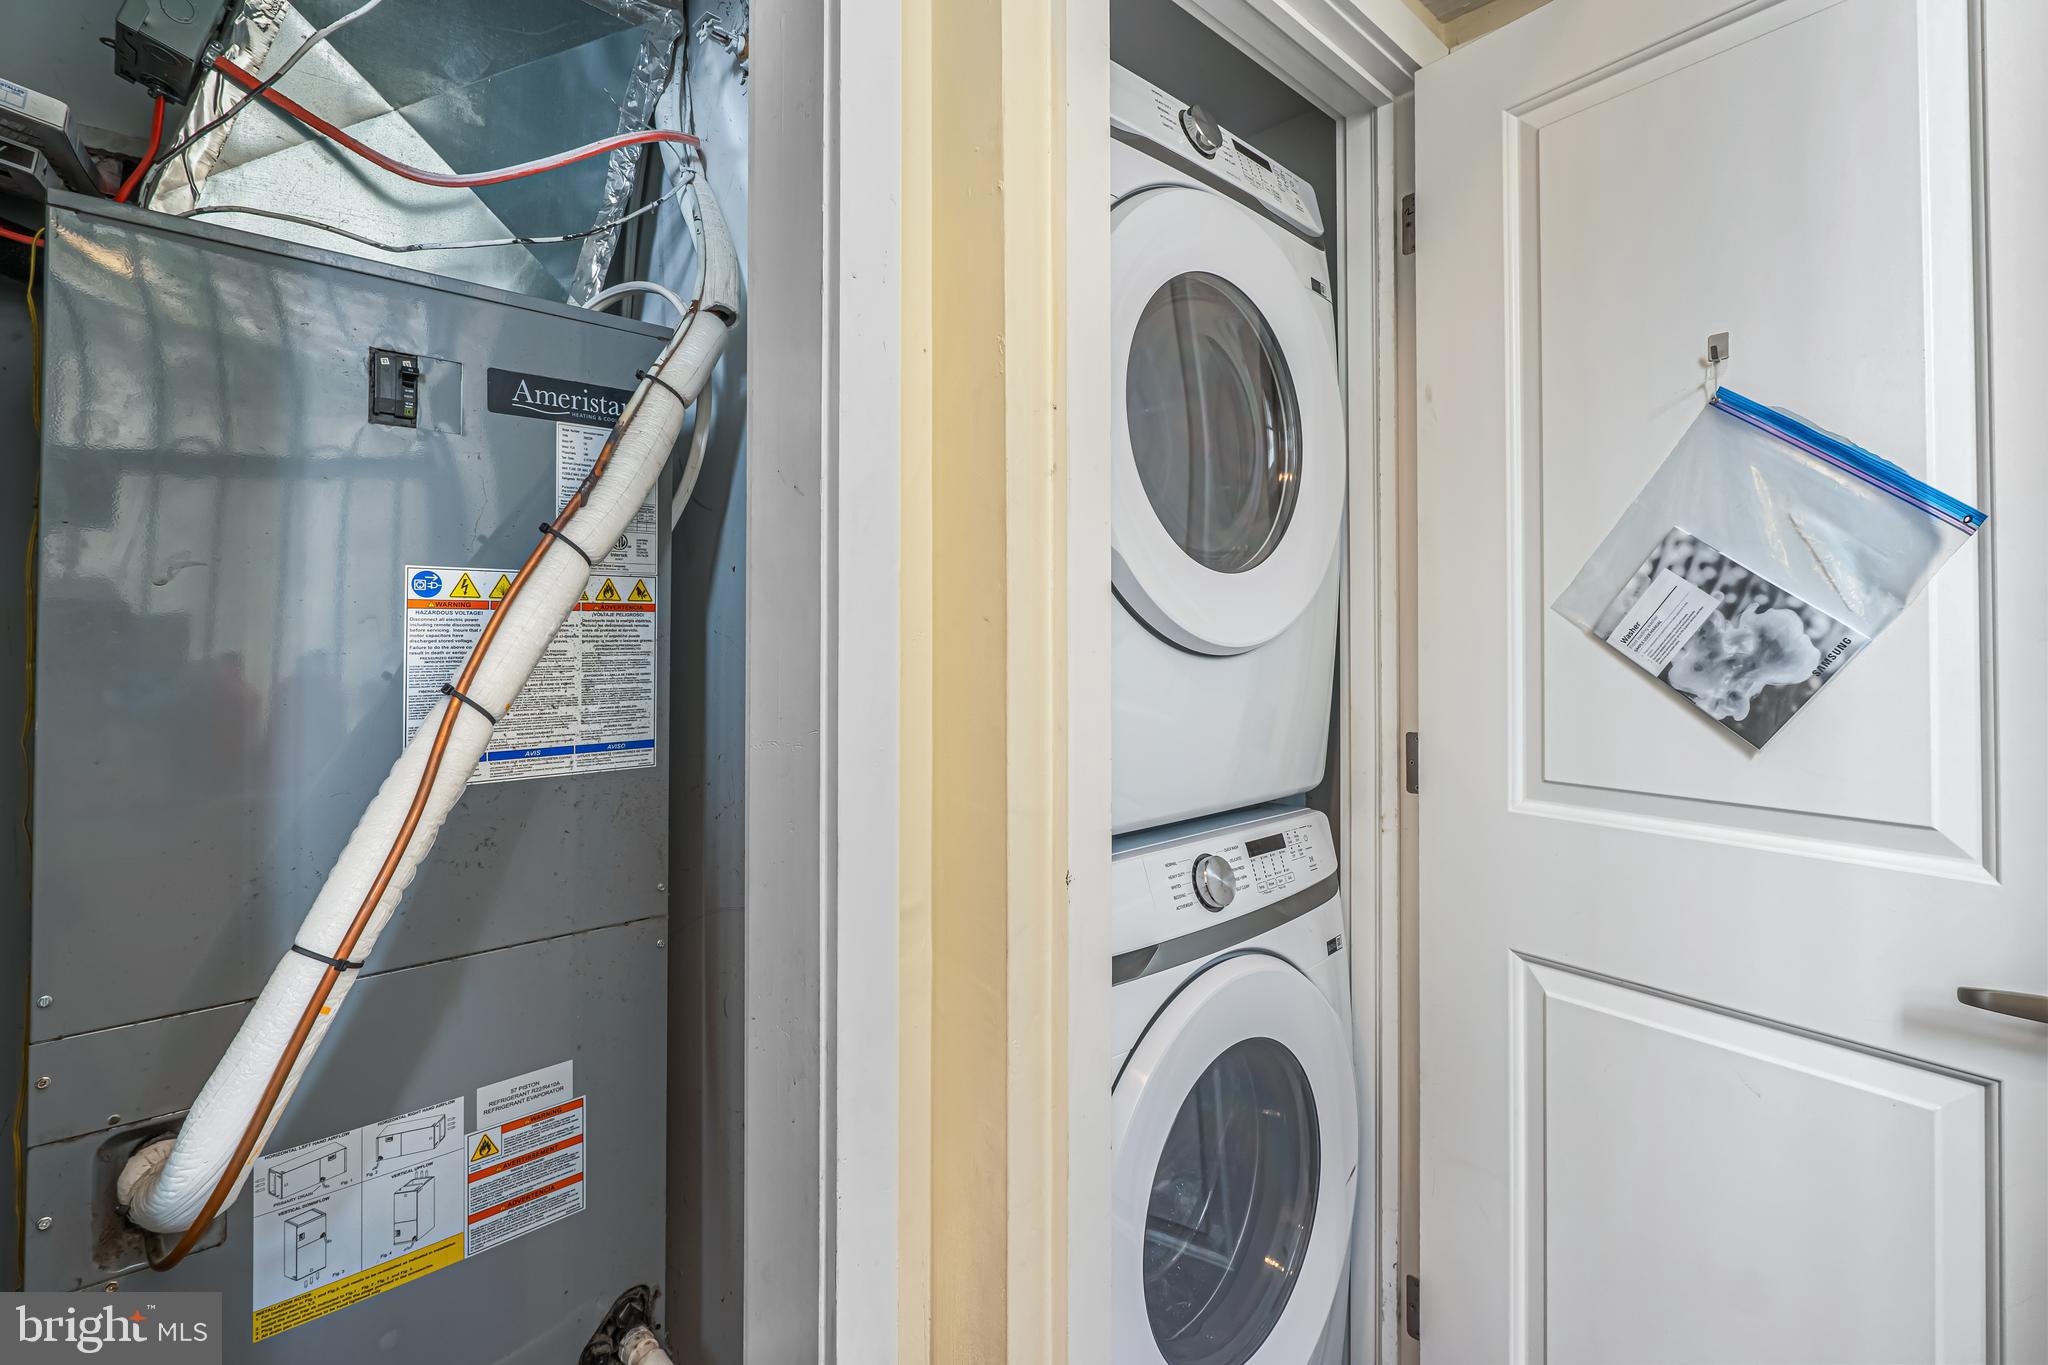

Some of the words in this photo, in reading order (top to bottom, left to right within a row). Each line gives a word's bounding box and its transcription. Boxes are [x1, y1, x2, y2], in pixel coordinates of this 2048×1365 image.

[571, 412, 597, 420] HEATING
[1620, 622, 1641, 644] Washer
[1812, 637, 1852, 676] SAMSUNG
[519, 1081, 540, 1091] PISTON
[483, 1096, 525, 1115] REFRIGERANT
[526, 1086, 564, 1102] EVAPORATOR
[489, 1090, 530, 1107] REFRIGERANT
[378, 1115, 406, 1126] HORIZONTAL
[436, 1100, 456, 1108] AIRFLOW
[531, 1108, 562, 1122] WARNING
[264, 1148, 297, 1160] HORIZONTAL
[328, 1132, 350, 1141] AIRFLOW
[391, 1168, 414, 1178] VERTICAL
[273, 1198, 296, 1207] PRIMARY
[297, 1192, 313, 1200] DRAIN
[508, 1185, 555, 1206] ADVERTENCIA
[278, 1207, 301, 1216] VERTICAL
[256, 1300, 293, 1316] INSTALLATION
